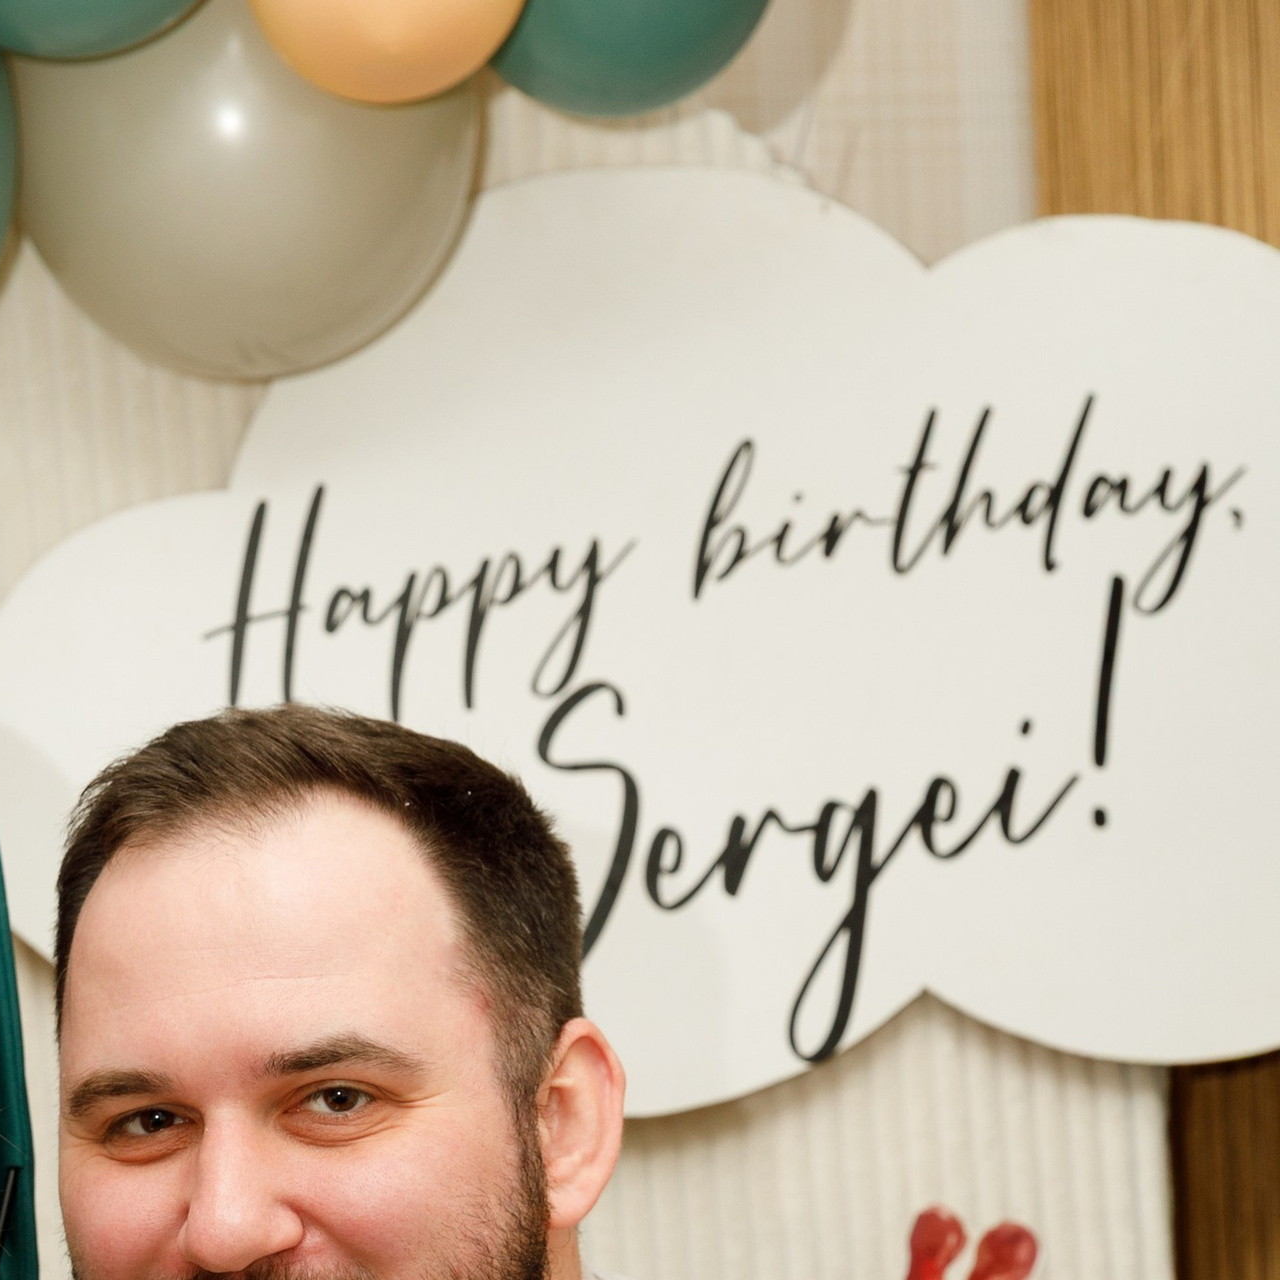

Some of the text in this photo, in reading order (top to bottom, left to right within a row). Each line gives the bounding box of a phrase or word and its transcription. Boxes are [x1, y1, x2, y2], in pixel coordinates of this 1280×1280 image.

[204, 394, 1246, 720] Happy birthday,
[537, 574, 1128, 1061] Sergei!
